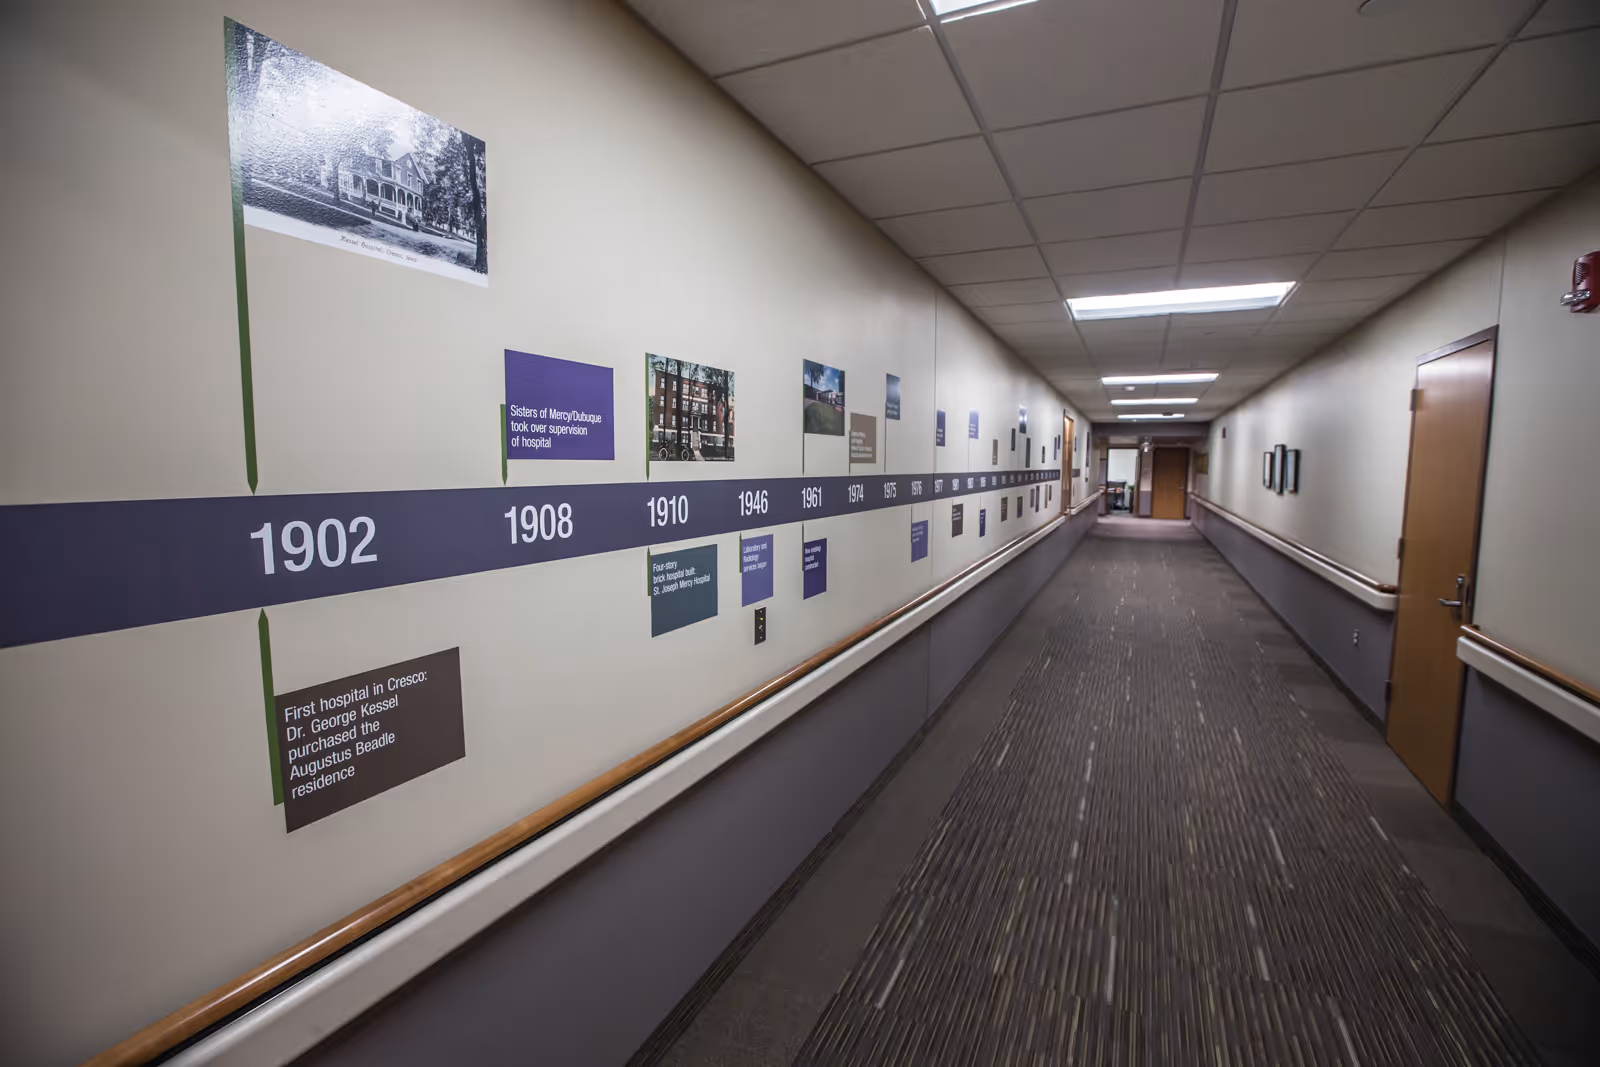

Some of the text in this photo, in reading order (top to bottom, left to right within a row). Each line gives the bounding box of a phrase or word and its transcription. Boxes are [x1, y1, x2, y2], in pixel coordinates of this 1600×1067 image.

[510, 404, 602, 424] Sisters of Mercy/Dubuque
[511, 420, 588, 436] took over supervision
[511, 435, 552, 449] of hospital
[250, 516, 378, 575] 1902
[504, 503, 574, 545] 1908
[647, 494, 689, 527] 1910
[738, 490, 769, 516] 1946
[801, 486, 822, 509] 1961
[848, 484, 864, 503] 1974
[883, 482, 897, 499] 1975
[653, 561, 678, 573] Four-story
[653, 573, 666, 585] brick
[666, 569, 685, 581] hospital
[653, 573, 711, 596] St. Joseph Mercy Hospital
[284, 671, 428, 723] First hospital in Cresco:
[286, 694, 399, 742] Dr. George Kessel
[288, 720, 380, 764] purchased the
[290, 732, 396, 780] Augustus Beadle
[292, 765, 355, 799] residence
